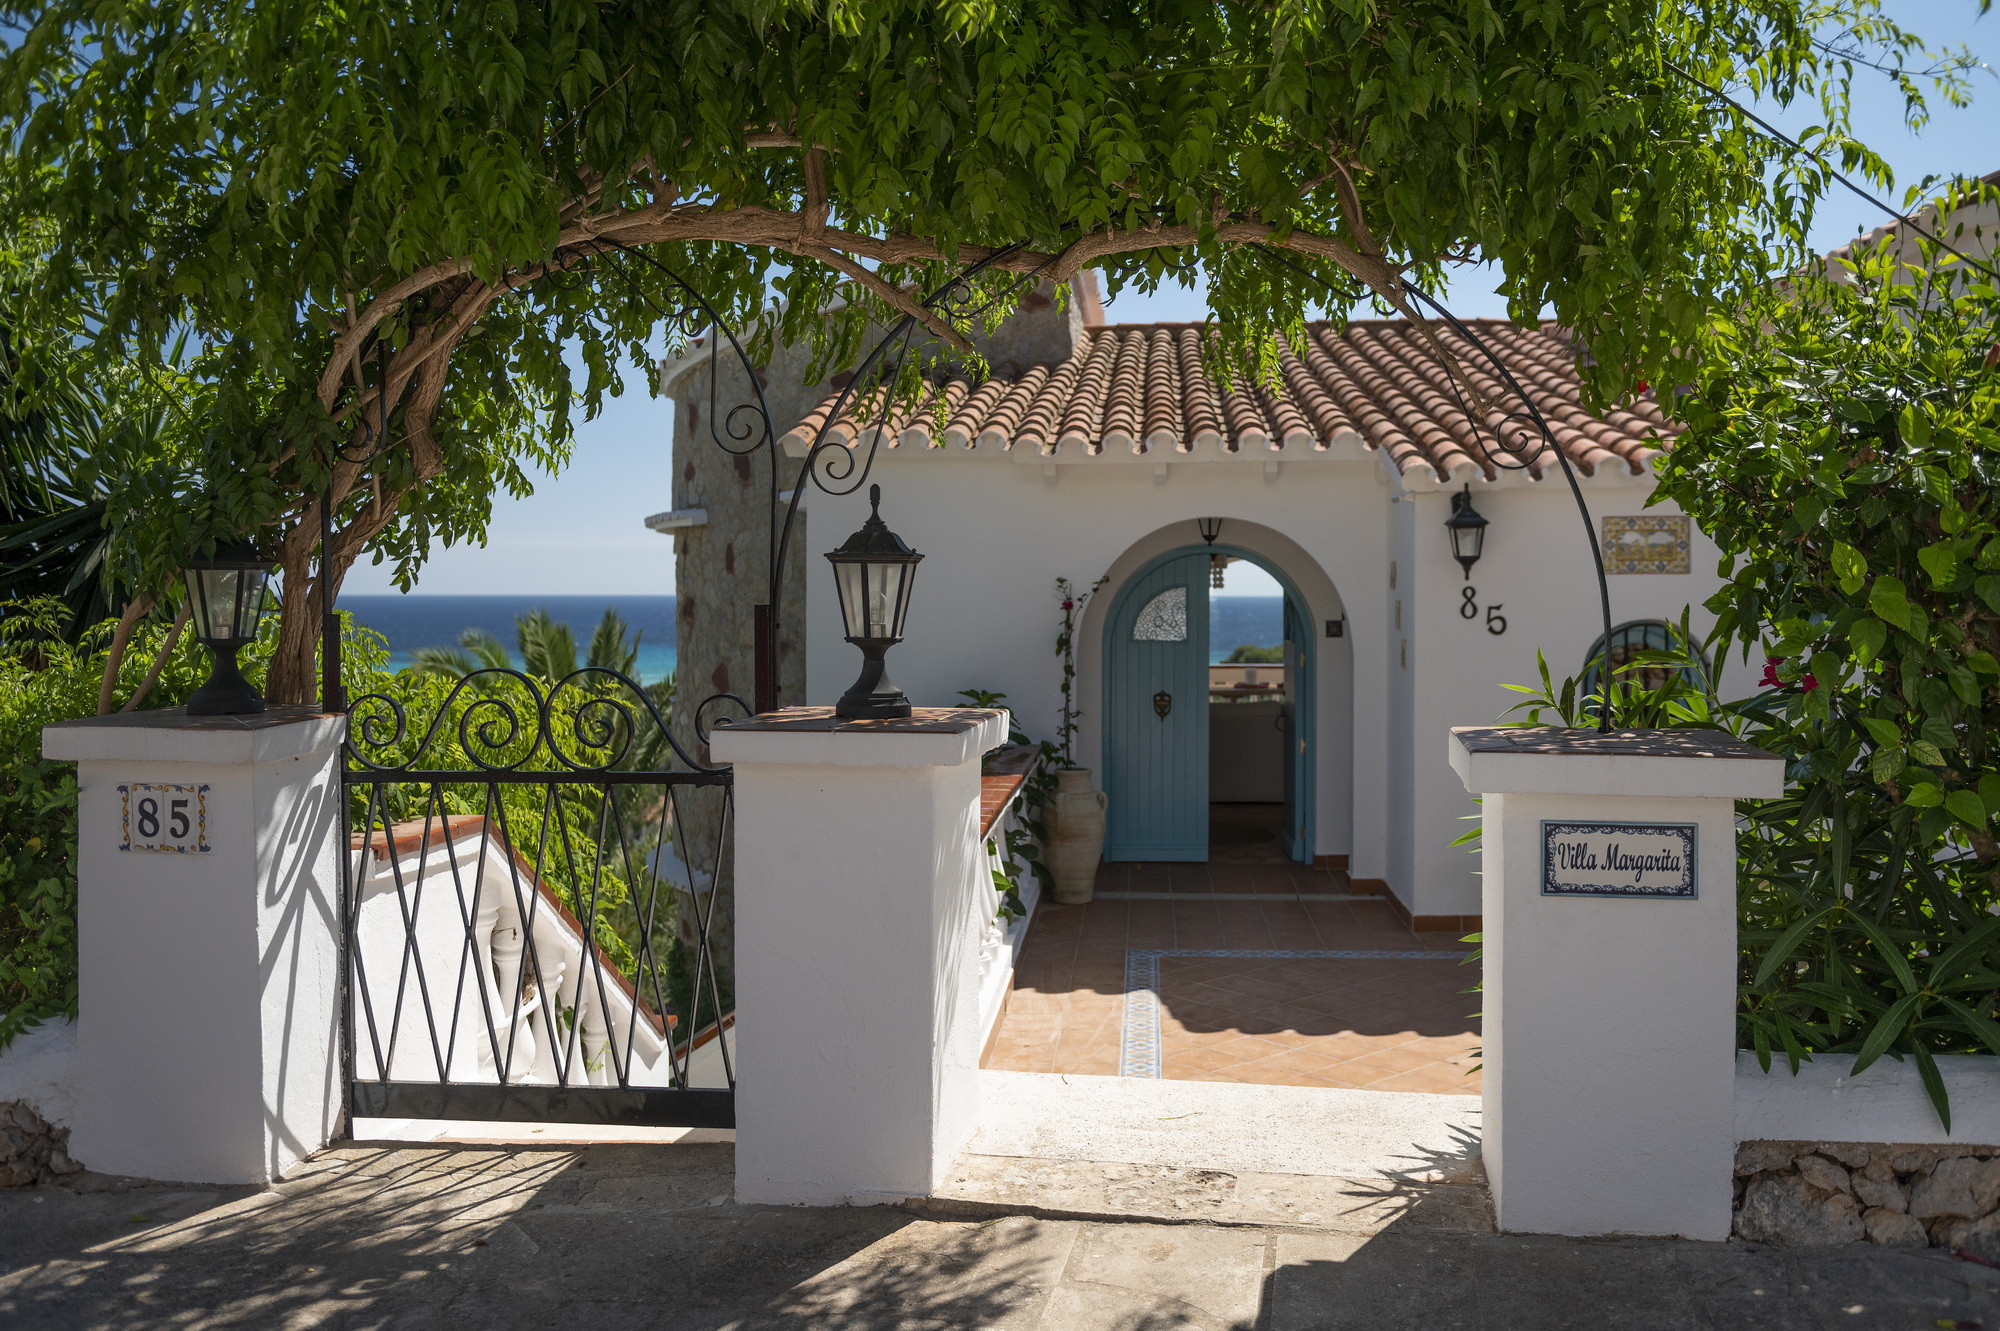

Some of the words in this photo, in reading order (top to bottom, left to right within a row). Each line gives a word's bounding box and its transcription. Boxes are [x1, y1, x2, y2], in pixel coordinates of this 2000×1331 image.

[1460, 586, 1507, 636] 85
[138, 798, 190, 838] 85
[1558, 843, 1597, 870] Villa
[1601, 843, 1681, 883] Margarita
